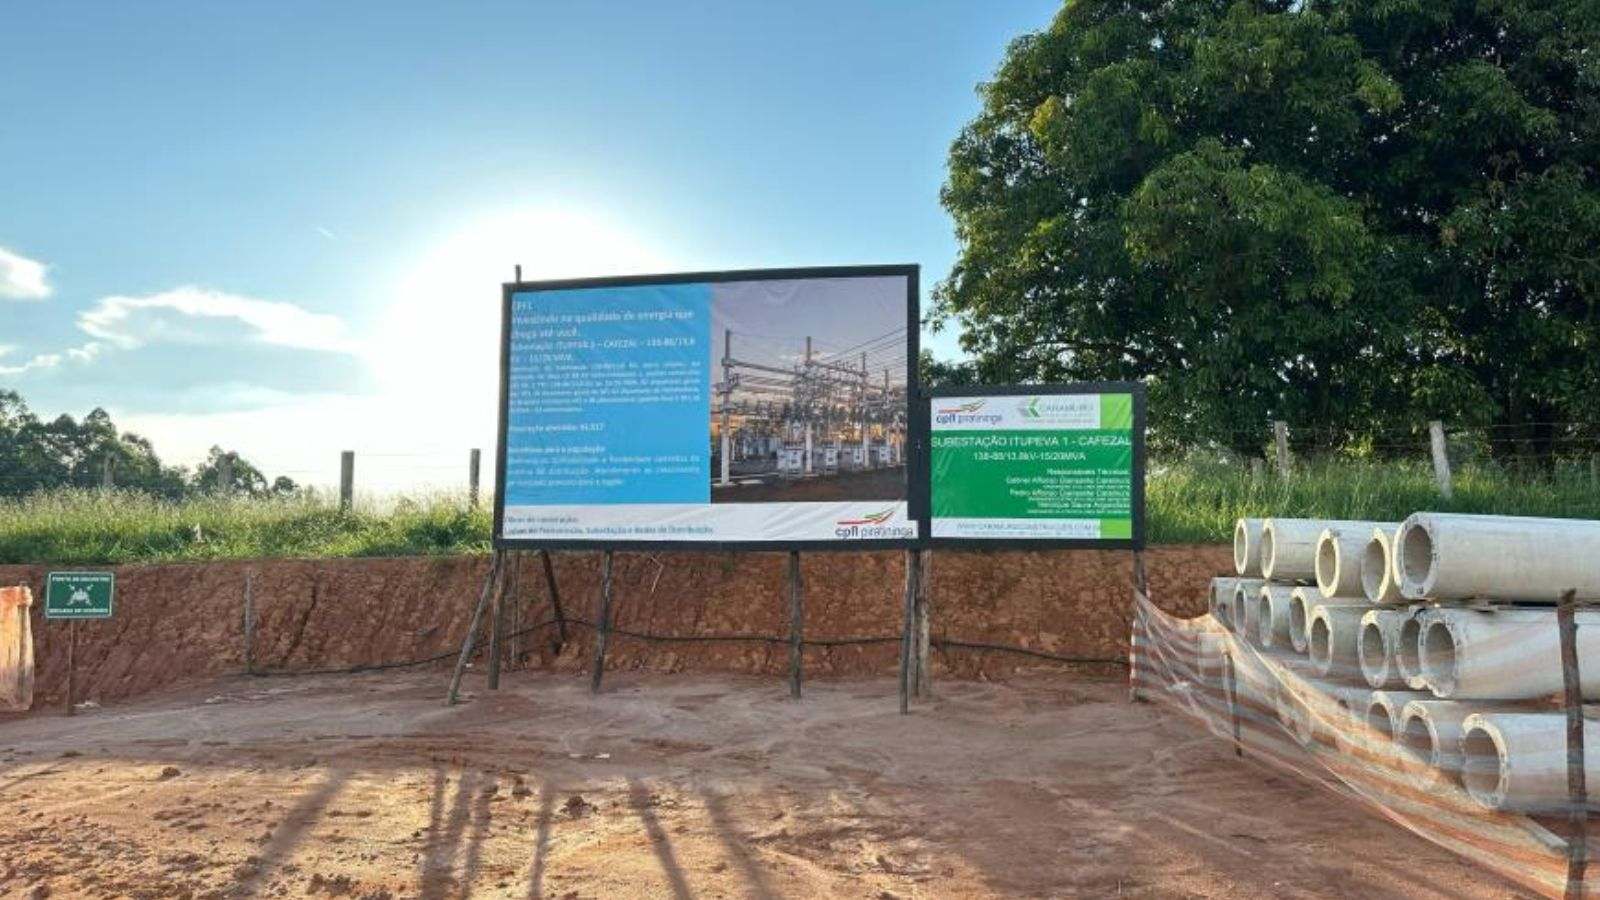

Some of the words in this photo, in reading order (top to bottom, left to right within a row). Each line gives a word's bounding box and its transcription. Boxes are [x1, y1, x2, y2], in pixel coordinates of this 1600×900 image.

[936, 413, 956, 426] cpfl
[931, 434, 1008, 450] SUBESTAÇÃO
[1009, 436, 1060, 447] ITUPEVA
[1078, 434, 1131, 447] CAFEZAL
[834, 525, 859, 540] cpfl
